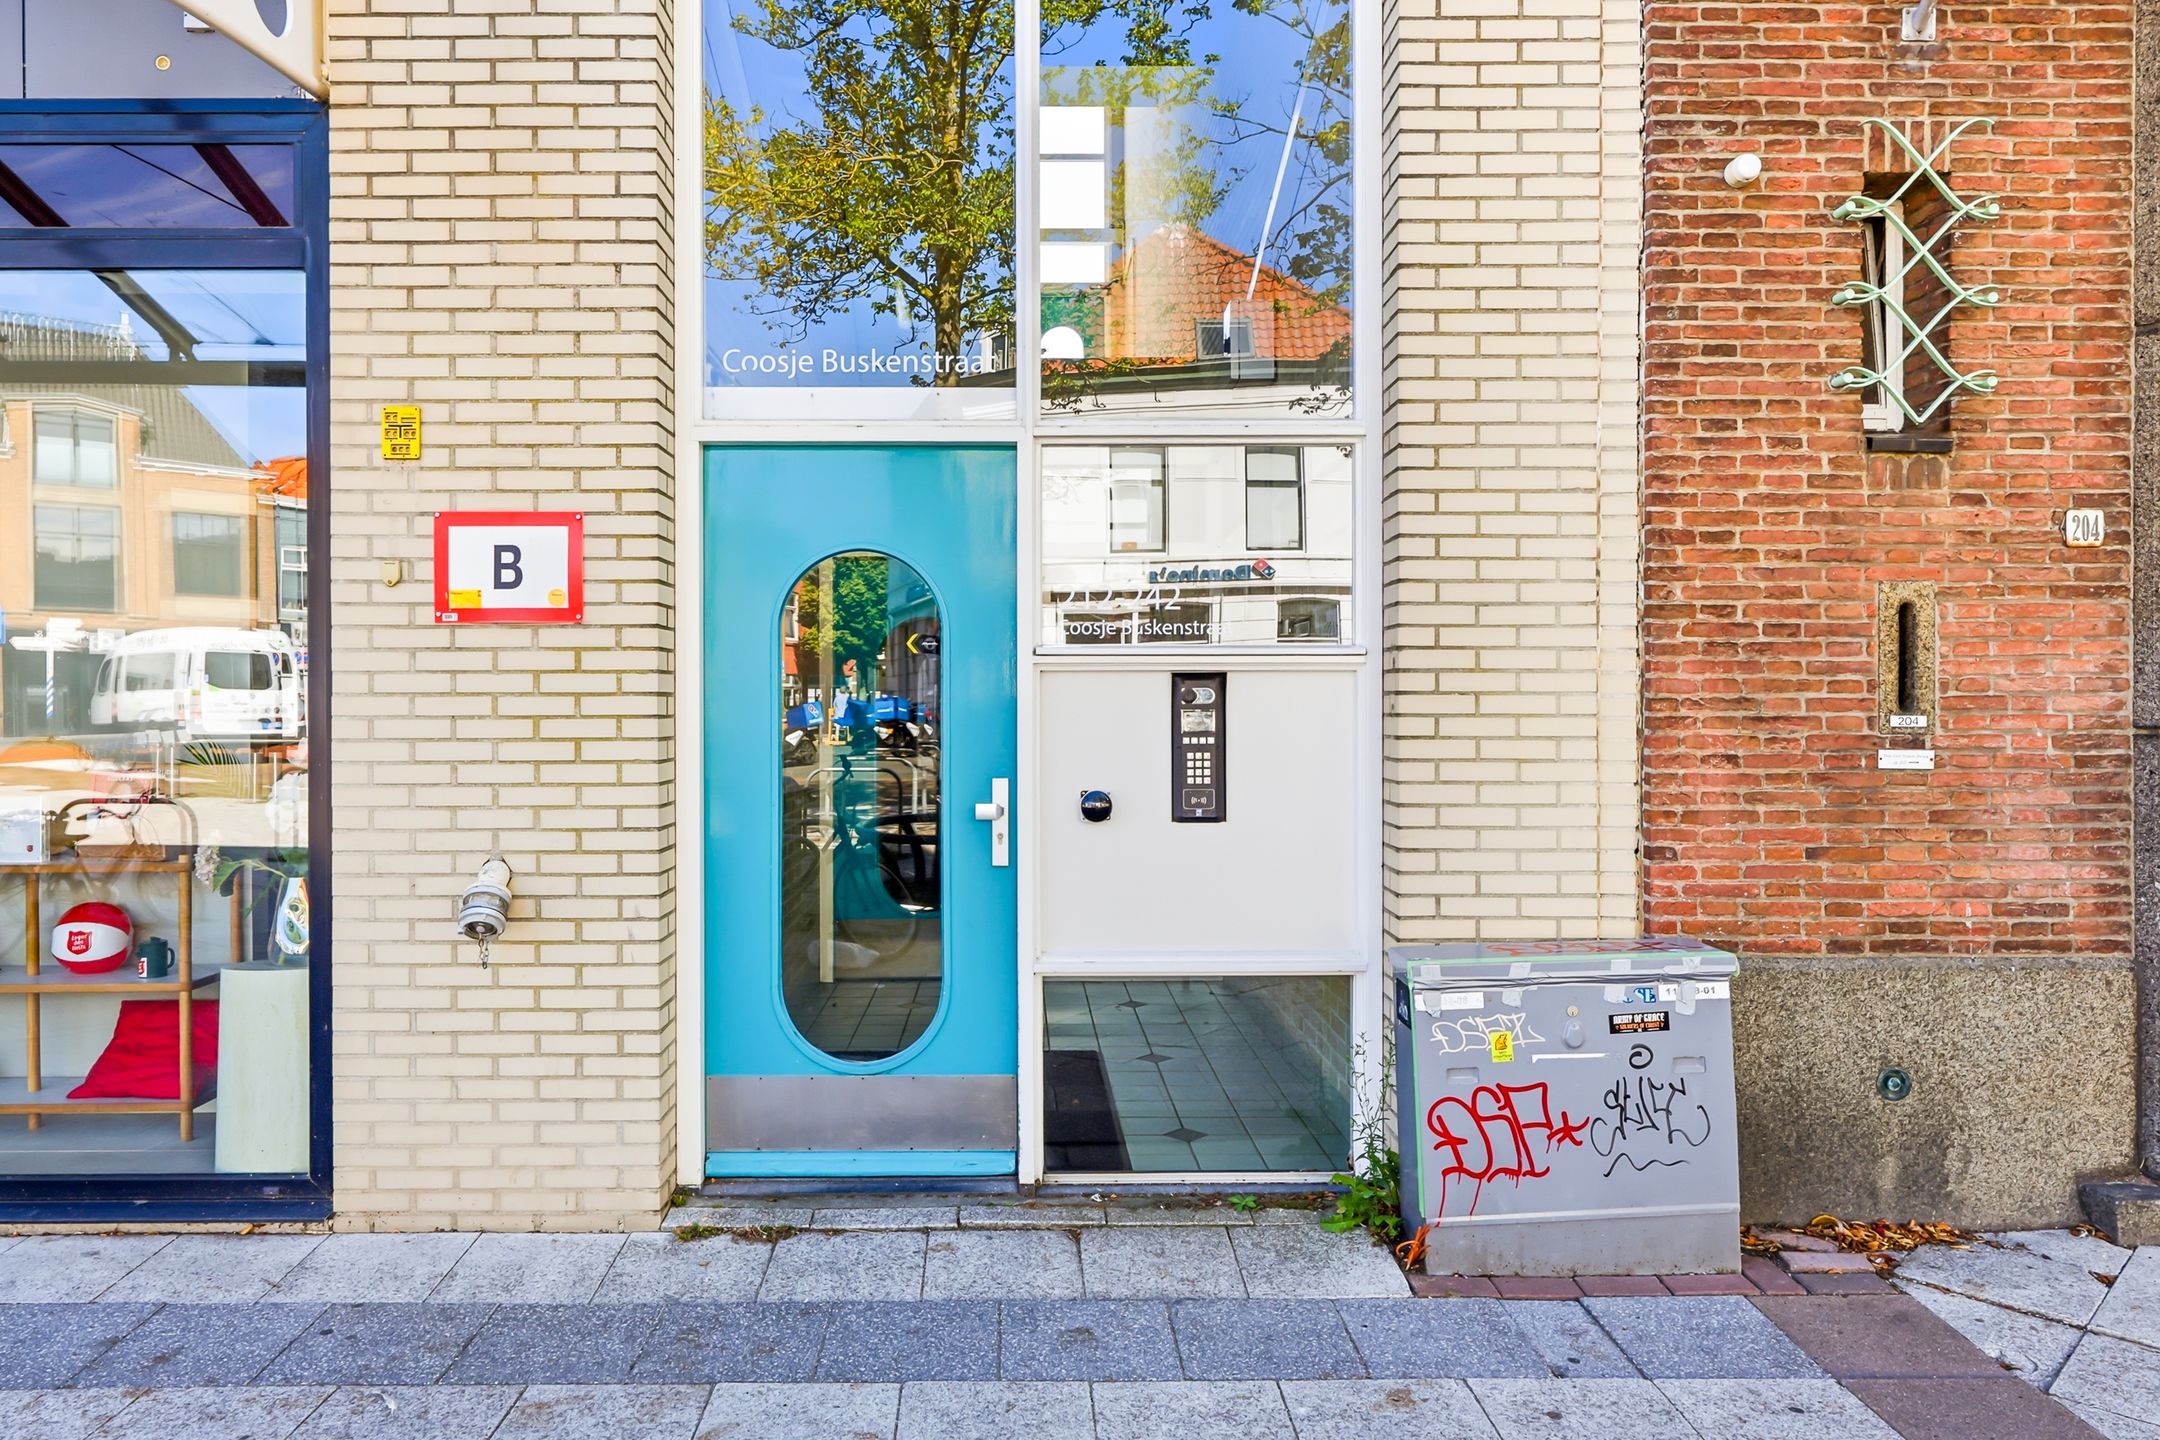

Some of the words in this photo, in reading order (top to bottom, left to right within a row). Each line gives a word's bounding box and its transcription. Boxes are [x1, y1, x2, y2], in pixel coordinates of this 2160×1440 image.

[722, 349, 814, 379] Coosje
[822, 348, 998, 373] Buskenstraat
[2071, 514, 2101, 542] 204
[493, 544, 524, 590] B
[1897, 716, 1920, 726] 204
